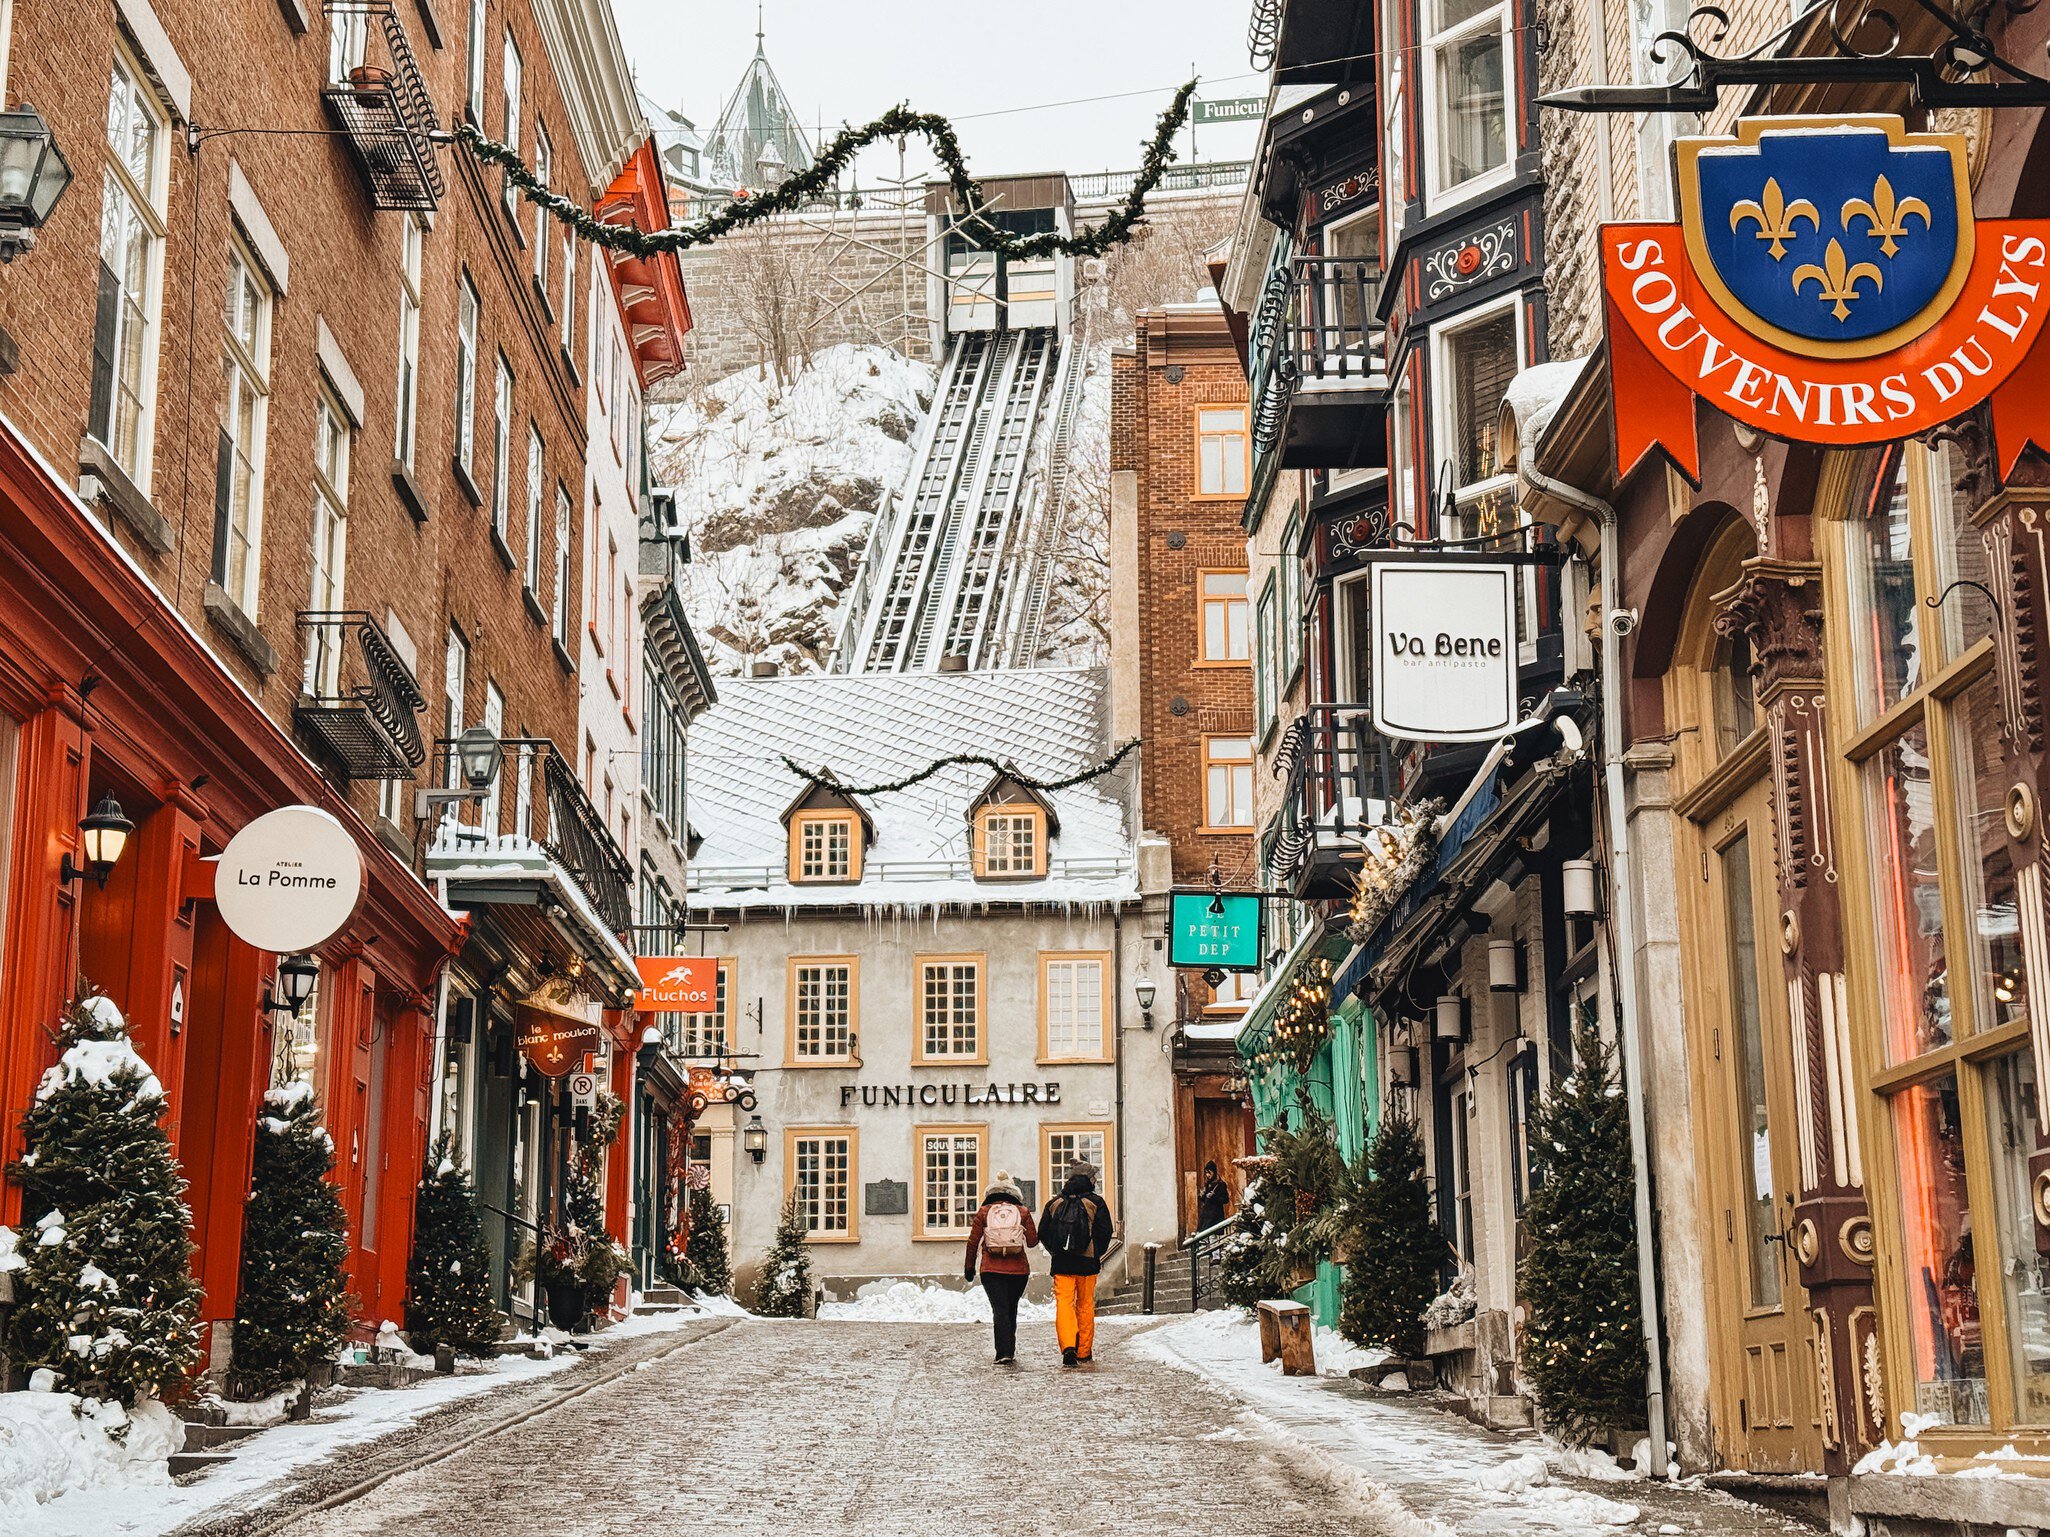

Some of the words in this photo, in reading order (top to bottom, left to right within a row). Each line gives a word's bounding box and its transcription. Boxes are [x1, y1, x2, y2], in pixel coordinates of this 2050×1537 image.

[1615, 238, 1917, 427] SOUVENIRS
[1920, 334, 1994, 404] DU
[1976, 234, 2047, 344] LYS
[1388, 632, 1425, 656] Va
[1434, 632, 1501, 657] Bene
[1403, 659, 1421, 667] bar
[1428, 660, 1486, 668] antipasto
[238, 868, 260, 886] La
[268, 870, 336, 889] Pomme
[1188, 924, 1241, 938] PETIT
[1199, 943, 1230, 956] DEP
[642, 987, 708, 1002] Fluchos
[530, 1024, 542, 1034] le
[517, 1034, 549, 1047] blanc
[839, 1082, 1061, 1107] FUNICULAIRE
